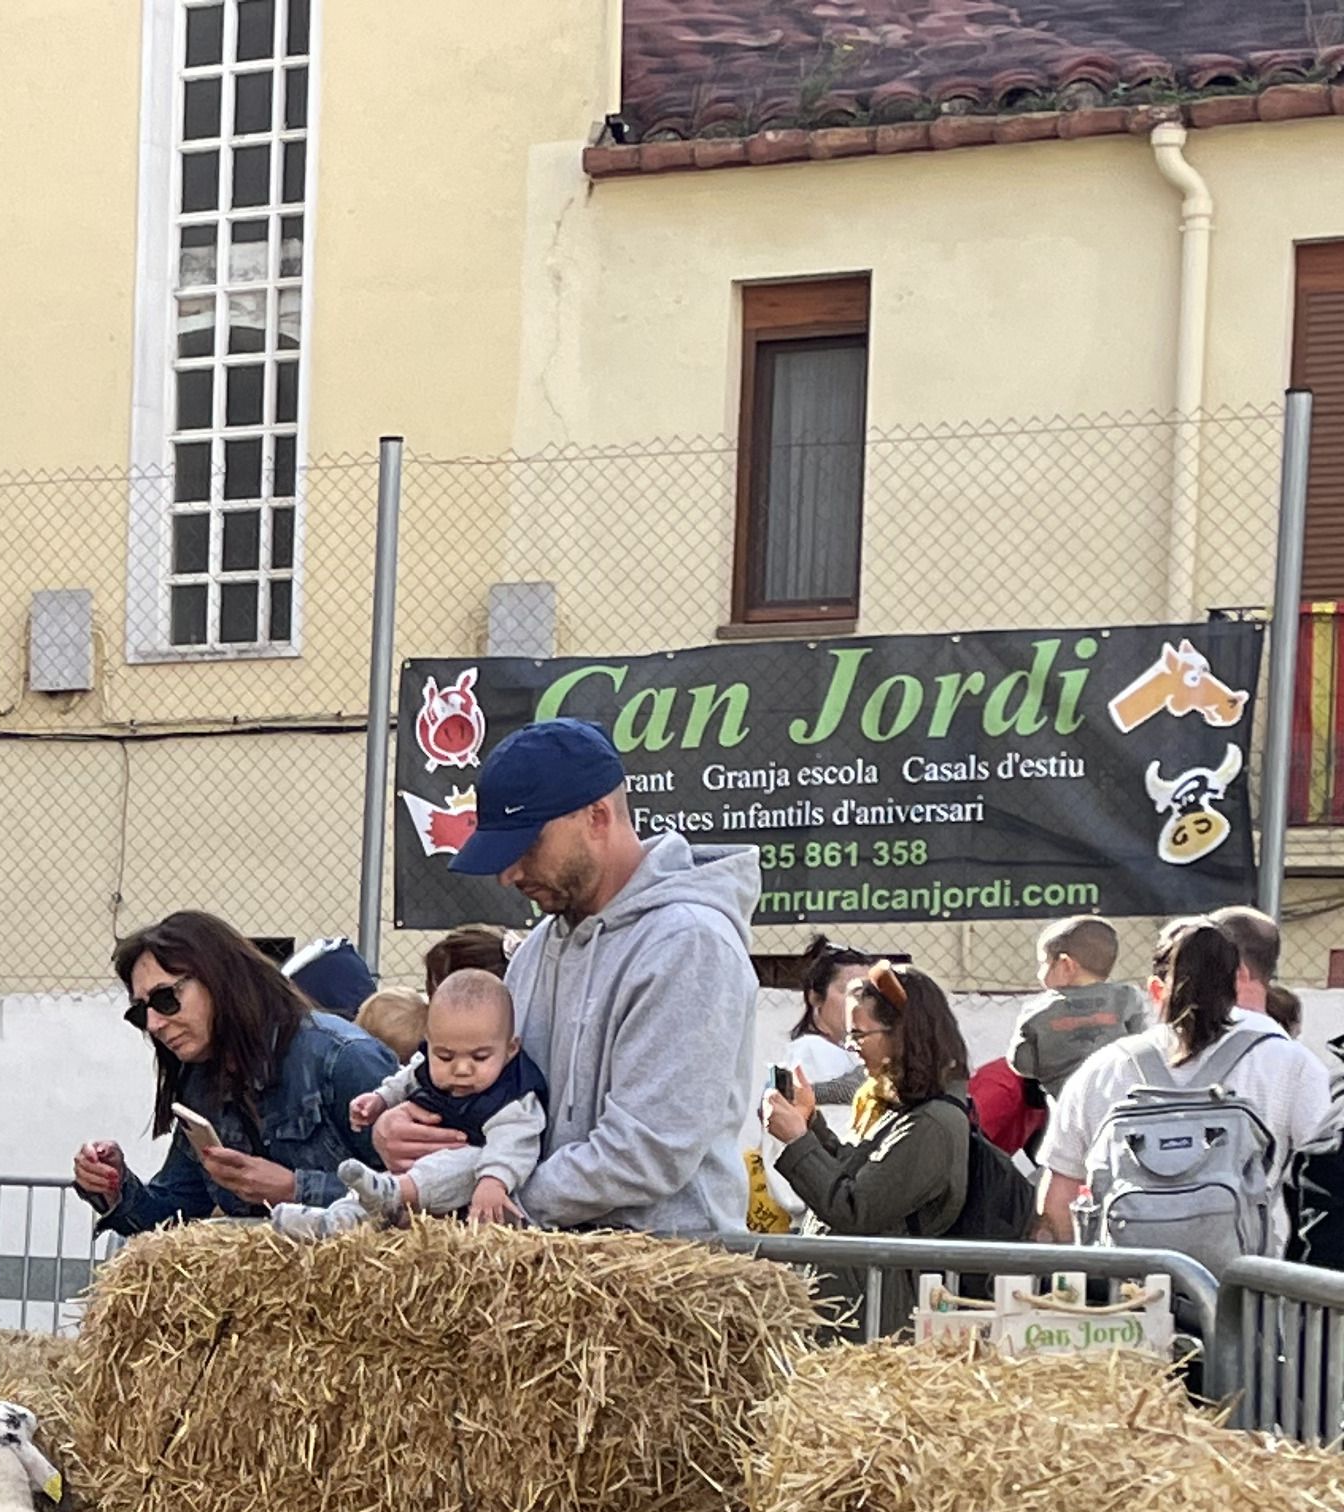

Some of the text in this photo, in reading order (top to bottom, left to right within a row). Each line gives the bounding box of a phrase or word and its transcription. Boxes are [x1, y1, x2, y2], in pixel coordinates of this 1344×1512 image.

[534, 637, 1099, 753] Can Jordi
[623, 751, 1086, 794] rant Granja escola Casals d'estiu
[634, 793, 985, 833] Festes infantils d'aniversari
[760, 839, 928, 870] 35 861 358
[759, 879, 1100, 916] rnruralcanjordi.com
[1024, 1321, 1071, 1349] Can
